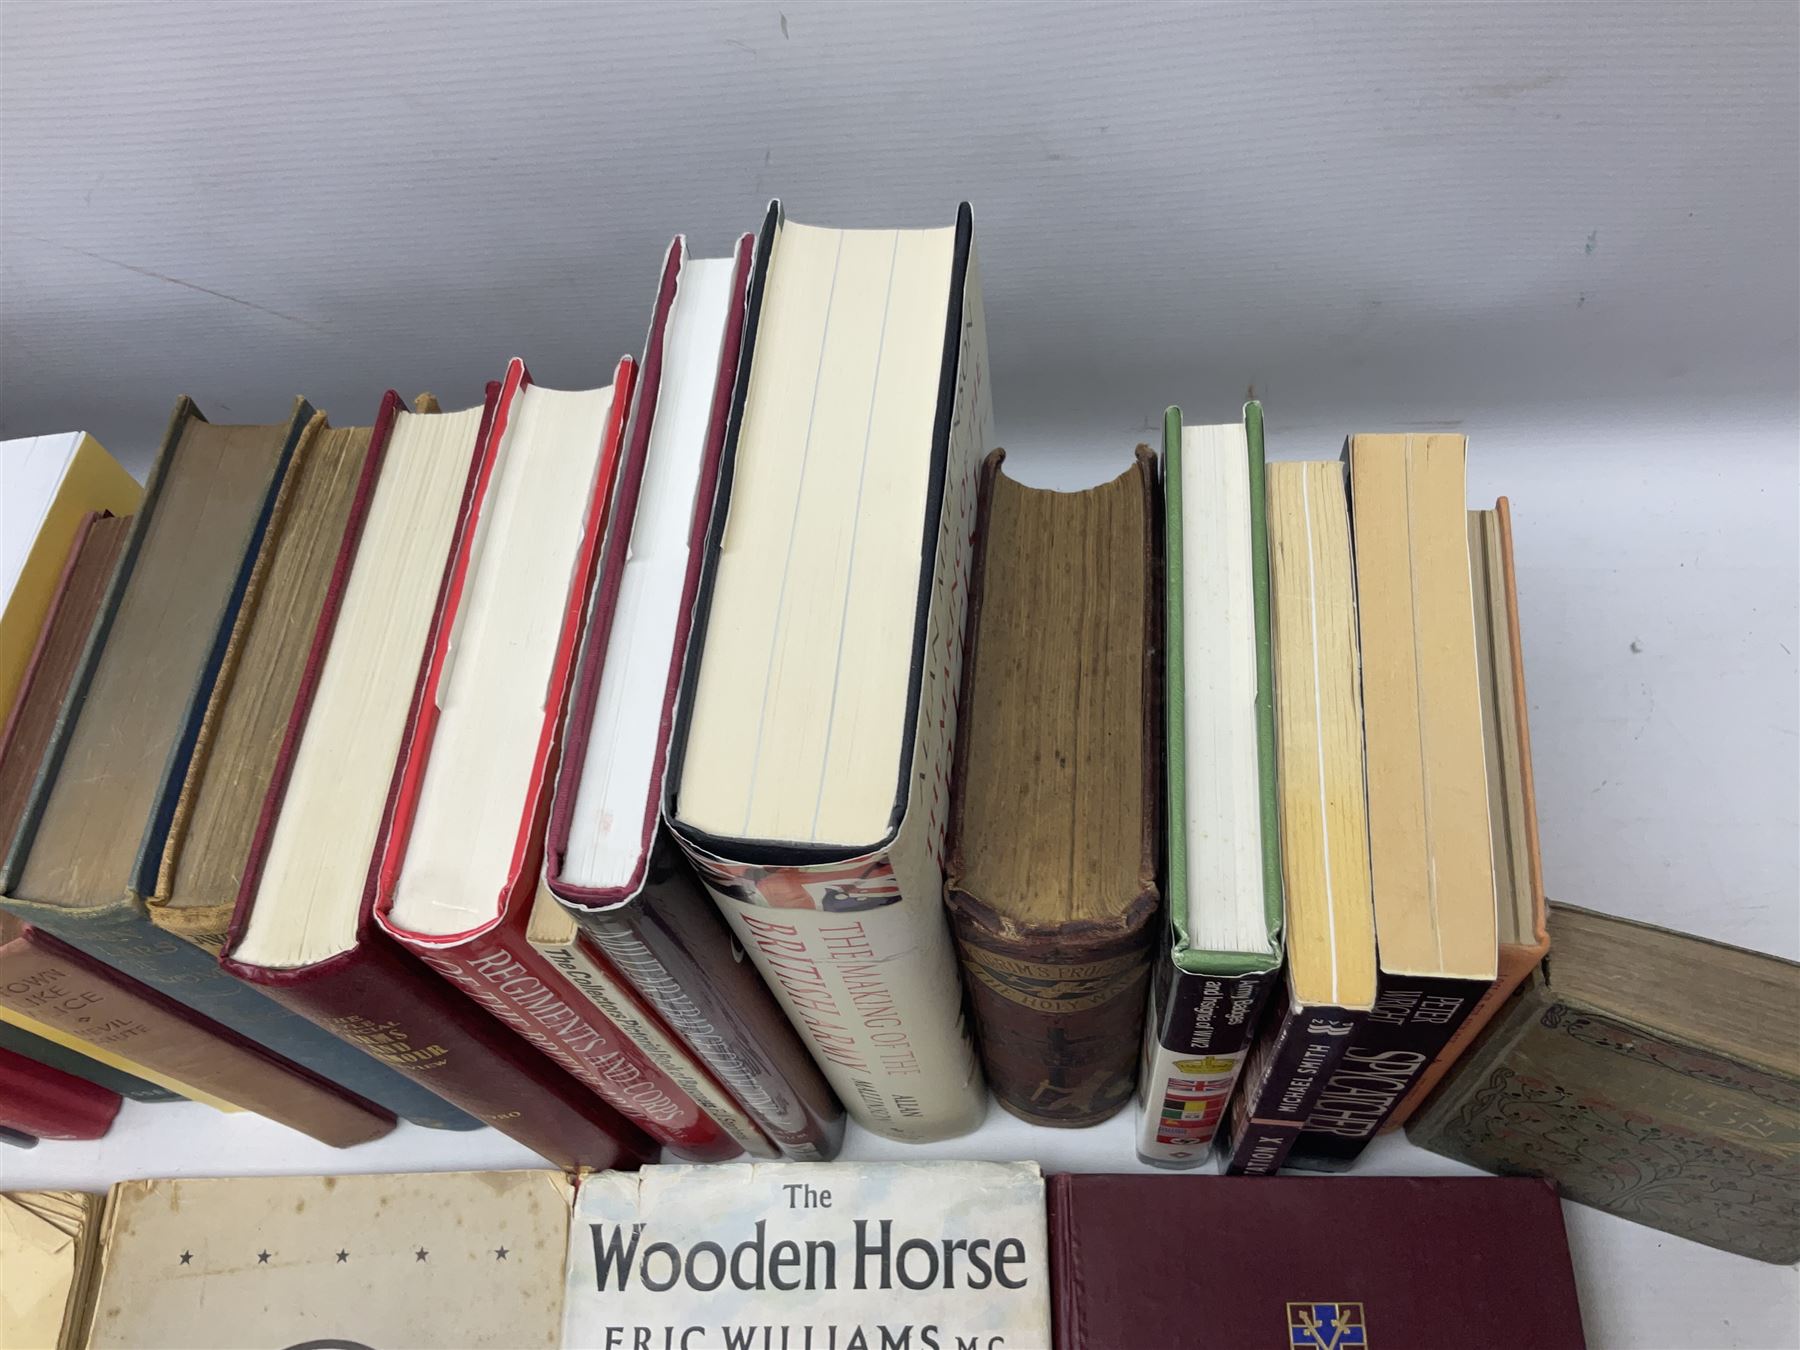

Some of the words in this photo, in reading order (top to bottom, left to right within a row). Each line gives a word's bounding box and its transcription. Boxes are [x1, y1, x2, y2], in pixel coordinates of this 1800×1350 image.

[818, 920, 875, 960] THE
[544, 948, 577, 970] The
[420, 955, 481, 989] OF
[463, 990, 532, 1028] THE
[740, 912, 842, 1017] BRITISH
[799, 1010, 872, 1075] ARMY
[836, 964, 902, 1029] MAKING
[1203, 981, 1224, 996] and
[1230, 979, 1260, 999] Army
[1023, 996, 1080, 1012] HOLY
[1193, 996, 1223, 1022] Insignia
[1224, 998, 1255, 1026] Badges
[1367, 989, 1424, 1026] WRIGHT
[1410, 994, 1465, 1024] PETER
[465, 948, 607, 1053] REGIMENTS
[583, 1050, 640, 1083] AND
[623, 1081, 685, 1122] CORPS
[870, 1031, 911, 1049] OF
[1190, 1029, 1215, 1049] WW2
[879, 1050, 921, 1076] THE
[1277, 1077, 1314, 1114] MICHAEL
[1296, 1043, 1332, 1075] SMITH
[1302, 1046, 1428, 1138] SPYCATCHER
[891, 1093, 924, 1118] ALLAN
[1258, 1135, 1285, 1145] X
[1243, 1146, 1279, 1176] ATION
[782, 1183, 833, 1209] The
[588, 1218, 838, 1292] Wooden
[852, 1218, 1029, 1291] Horse
[603, 1326, 706, 1350] ERIC
[721, 1324, 940, 1350] WILLIAMS
